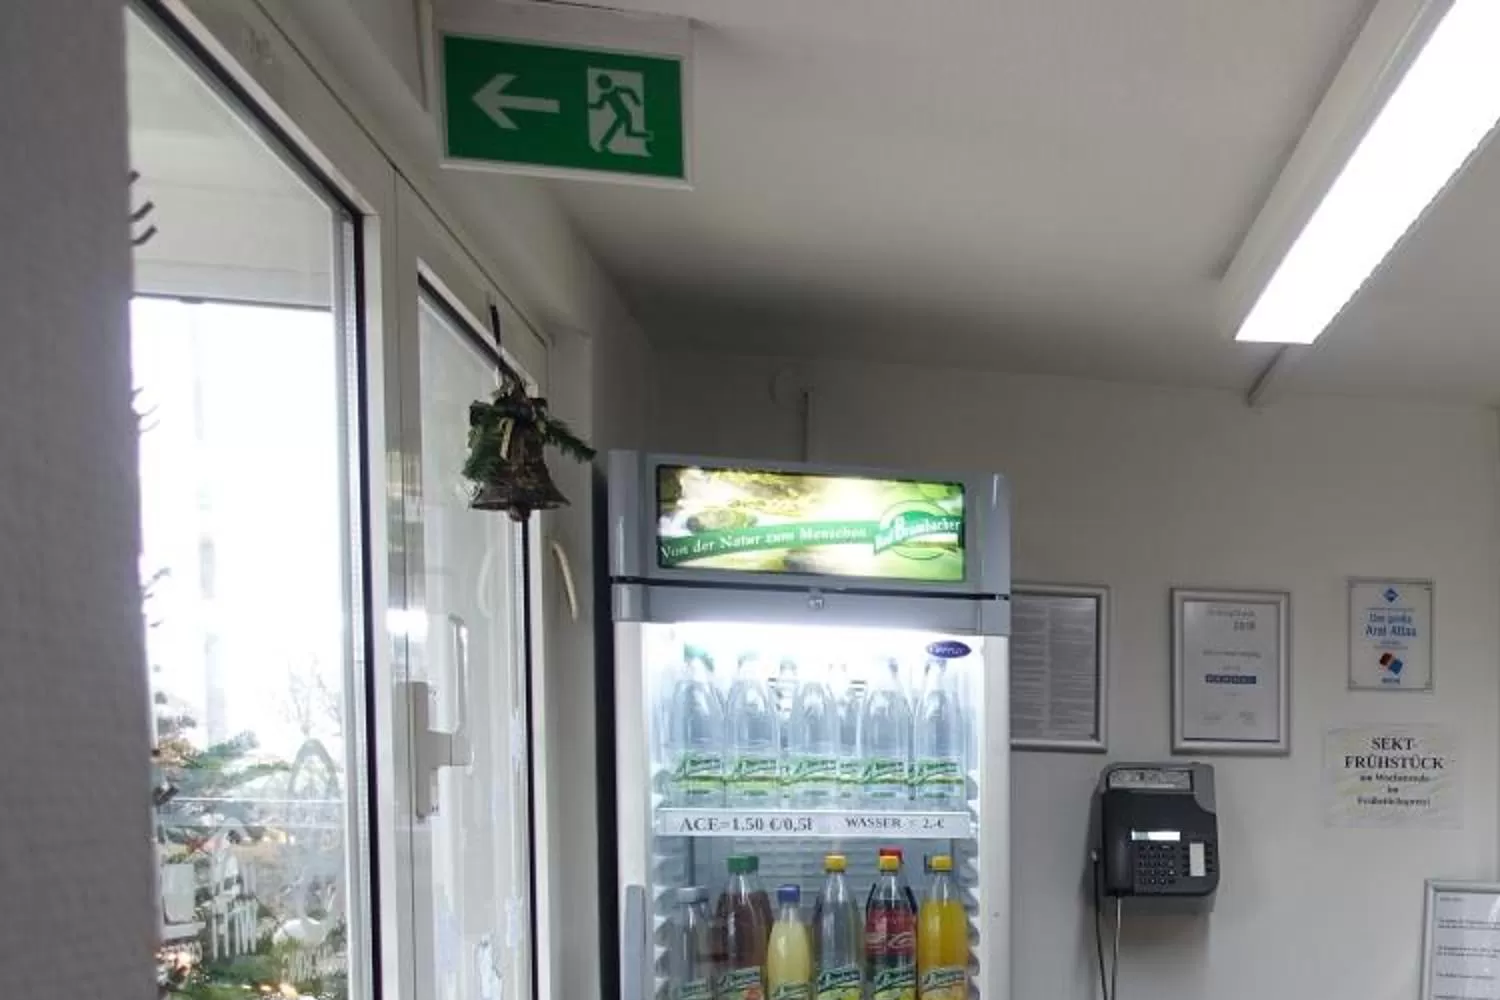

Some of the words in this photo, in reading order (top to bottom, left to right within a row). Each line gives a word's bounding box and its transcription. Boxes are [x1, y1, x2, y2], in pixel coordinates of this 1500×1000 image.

[693, 541, 713, 554] der
[720, 535, 760, 550] Natur
[1371, 737, 1418, 751] SEKT-
[1344, 755, 1445, 770] FRÜHSTÜCK
[846, 817, 901, 829] WASSER
